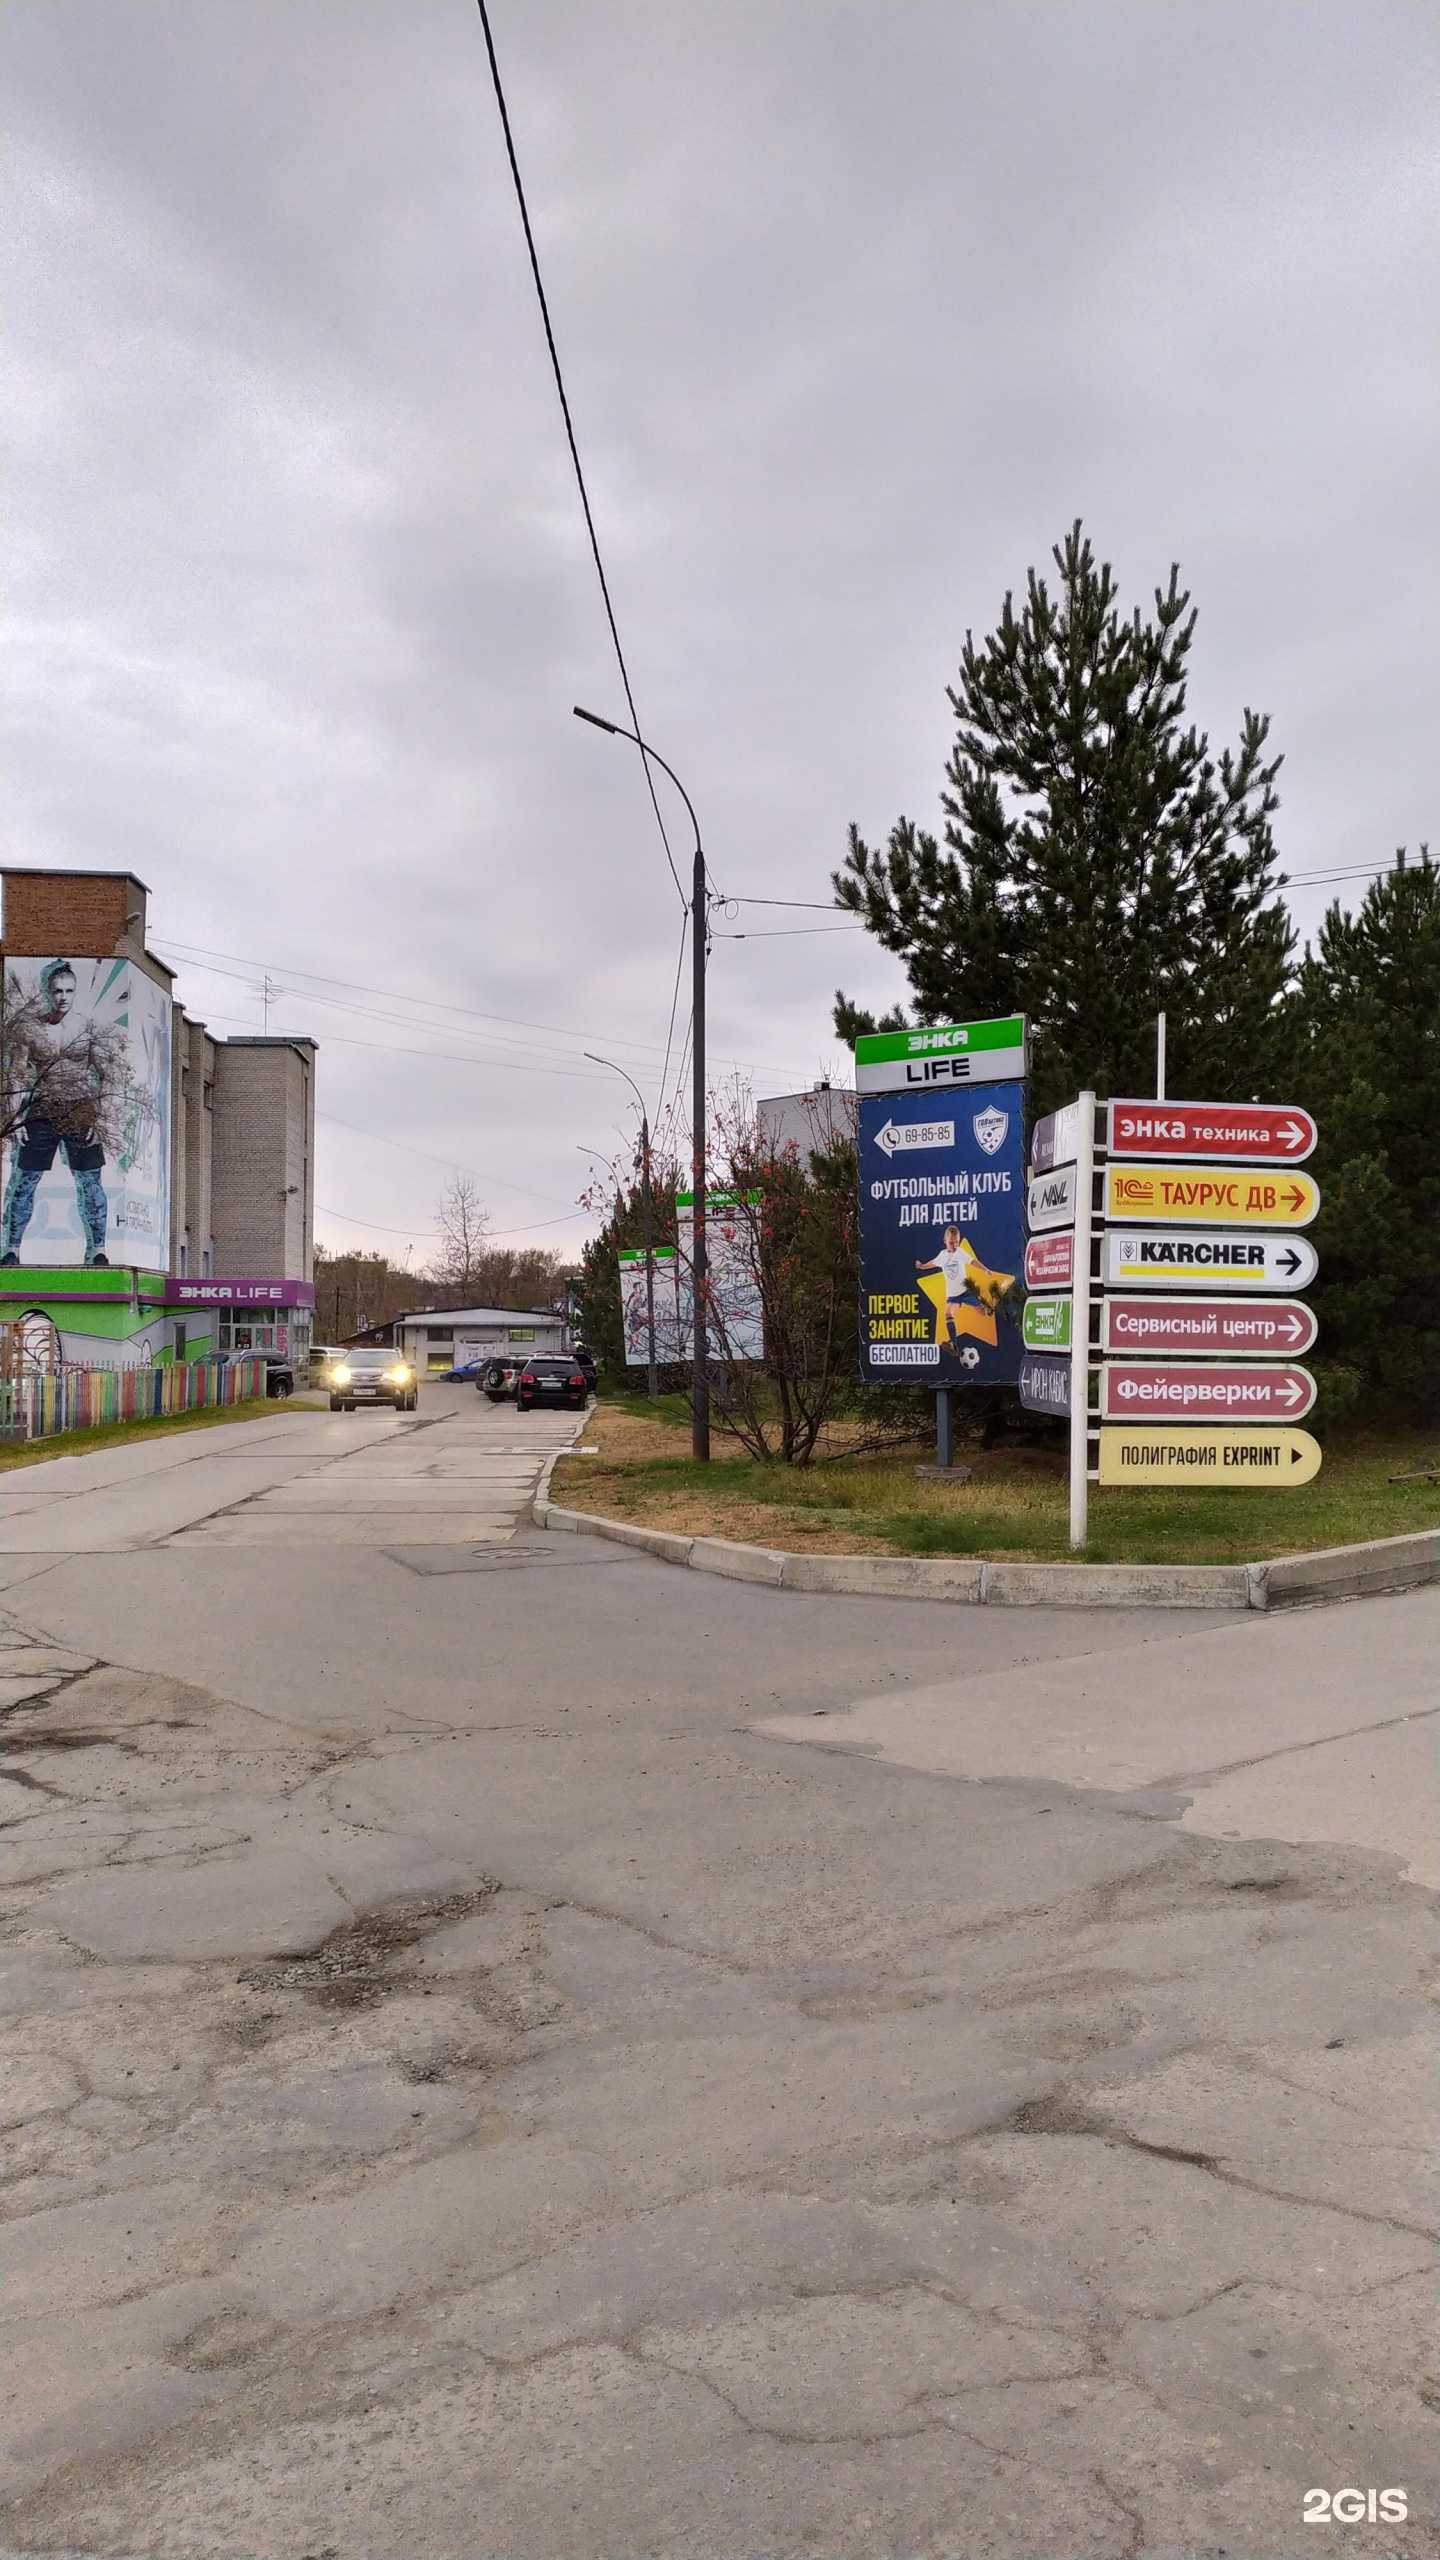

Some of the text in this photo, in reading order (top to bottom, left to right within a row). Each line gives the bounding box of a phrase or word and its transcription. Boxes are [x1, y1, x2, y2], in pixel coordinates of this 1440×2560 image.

[908, 1030, 968, 1051] ЭНКА
[906, 1058, 970, 1082] LIFE
[905, 1126, 950, 1143] 69-85-85
[1192, 1127, 1270, 1142] техника
[870, 1171, 1012, 1200] ФУТБОЛЬНЫЙ КЛУБ
[1160, 1182, 1239, 1207] ТАУРУС
[1246, 1186, 1276, 1212] ДВ
[899, 1198, 978, 1227] ДЛЯ ДЕТЕЙ
[1141, 1242, 1265, 1265] KÄRCHER
[179, 1287, 282, 1298] ЭНКА LIFE
[868, 1294, 919, 1315] ПЕРВОЕ
[868, 1319, 929, 1340] ЗАНЯТИЕ
[1116, 1313, 1276, 1339] Сервисный центр
[871, 1346, 938, 1363] БЕСПЛАТНО!
[1117, 1378, 1271, 1405] Фейерверки
[1121, 1446, 1281, 1466] ПОЛИГРАФИЯ EXPRINT
